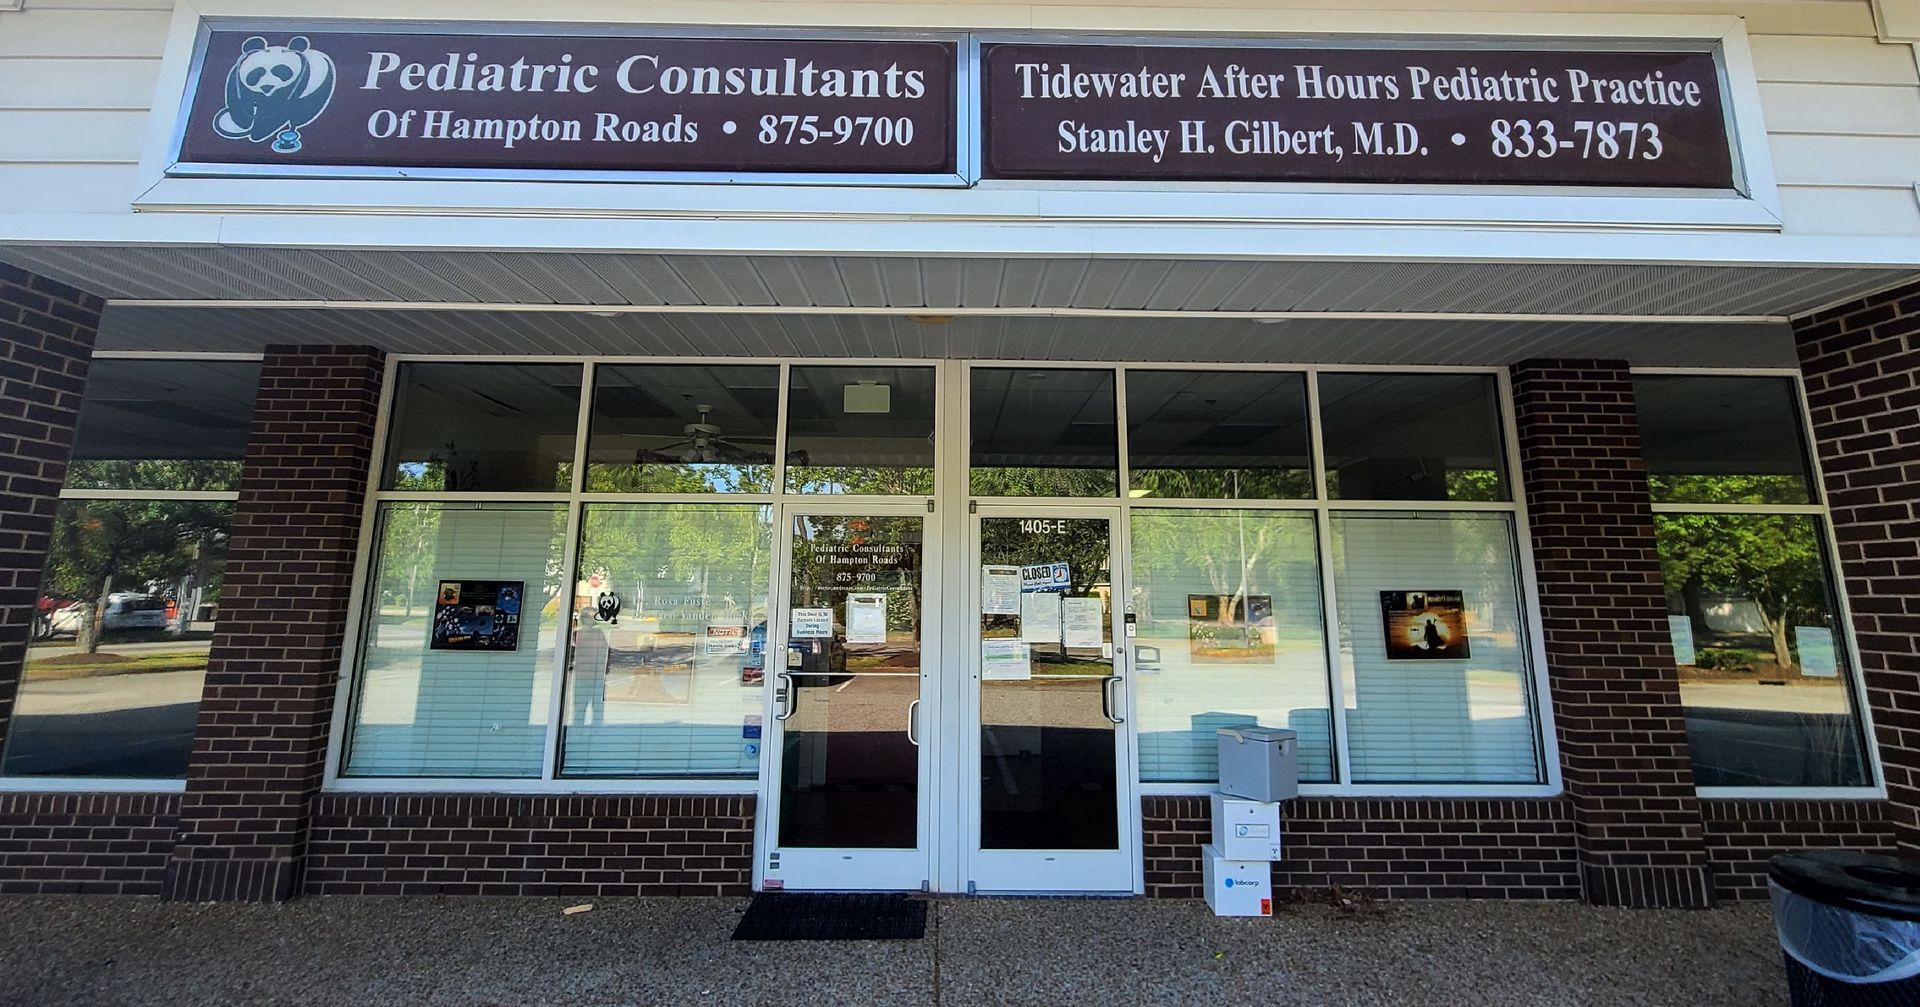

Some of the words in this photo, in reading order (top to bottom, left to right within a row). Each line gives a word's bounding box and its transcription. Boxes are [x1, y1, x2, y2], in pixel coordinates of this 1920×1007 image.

[359, 51, 598, 93] Pediatric
[616, 54, 925, 98] Consultants
[1015, 63, 1185, 98] Tidewater
[1197, 64, 1284, 98] After
[1293, 65, 1400, 100] Hours
[1406, 66, 1560, 103] Pediatric
[1565, 69, 1701, 106] Practice
[367, 109, 416, 139] Of
[420, 110, 581, 148] Hampton
[592, 112, 698, 143] Roads
[758, 114, 914, 146] 875-9700
[1058, 120, 1170, 162] Stanley
[1179, 120, 1215, 154] H.
[1224, 120, 1343, 162] Gilbert,
[1351, 122, 1428, 155] M.D.
[1491, 119, 1663, 160] 833-7873
[1019, 520, 1065, 533] 1405-E
[810, 544, 849, 552] Pediatric
[853, 544, 903, 552] Consultants
[816, 555, 826, 564] Of
[830, 555, 868, 565] Hampton
[872, 555, 898, 564] Roads
[836, 573, 876, 581] 875-9700
[1022, 566, 1051, 580] CLOSED
[1235, 879, 1259, 887] labcorp
